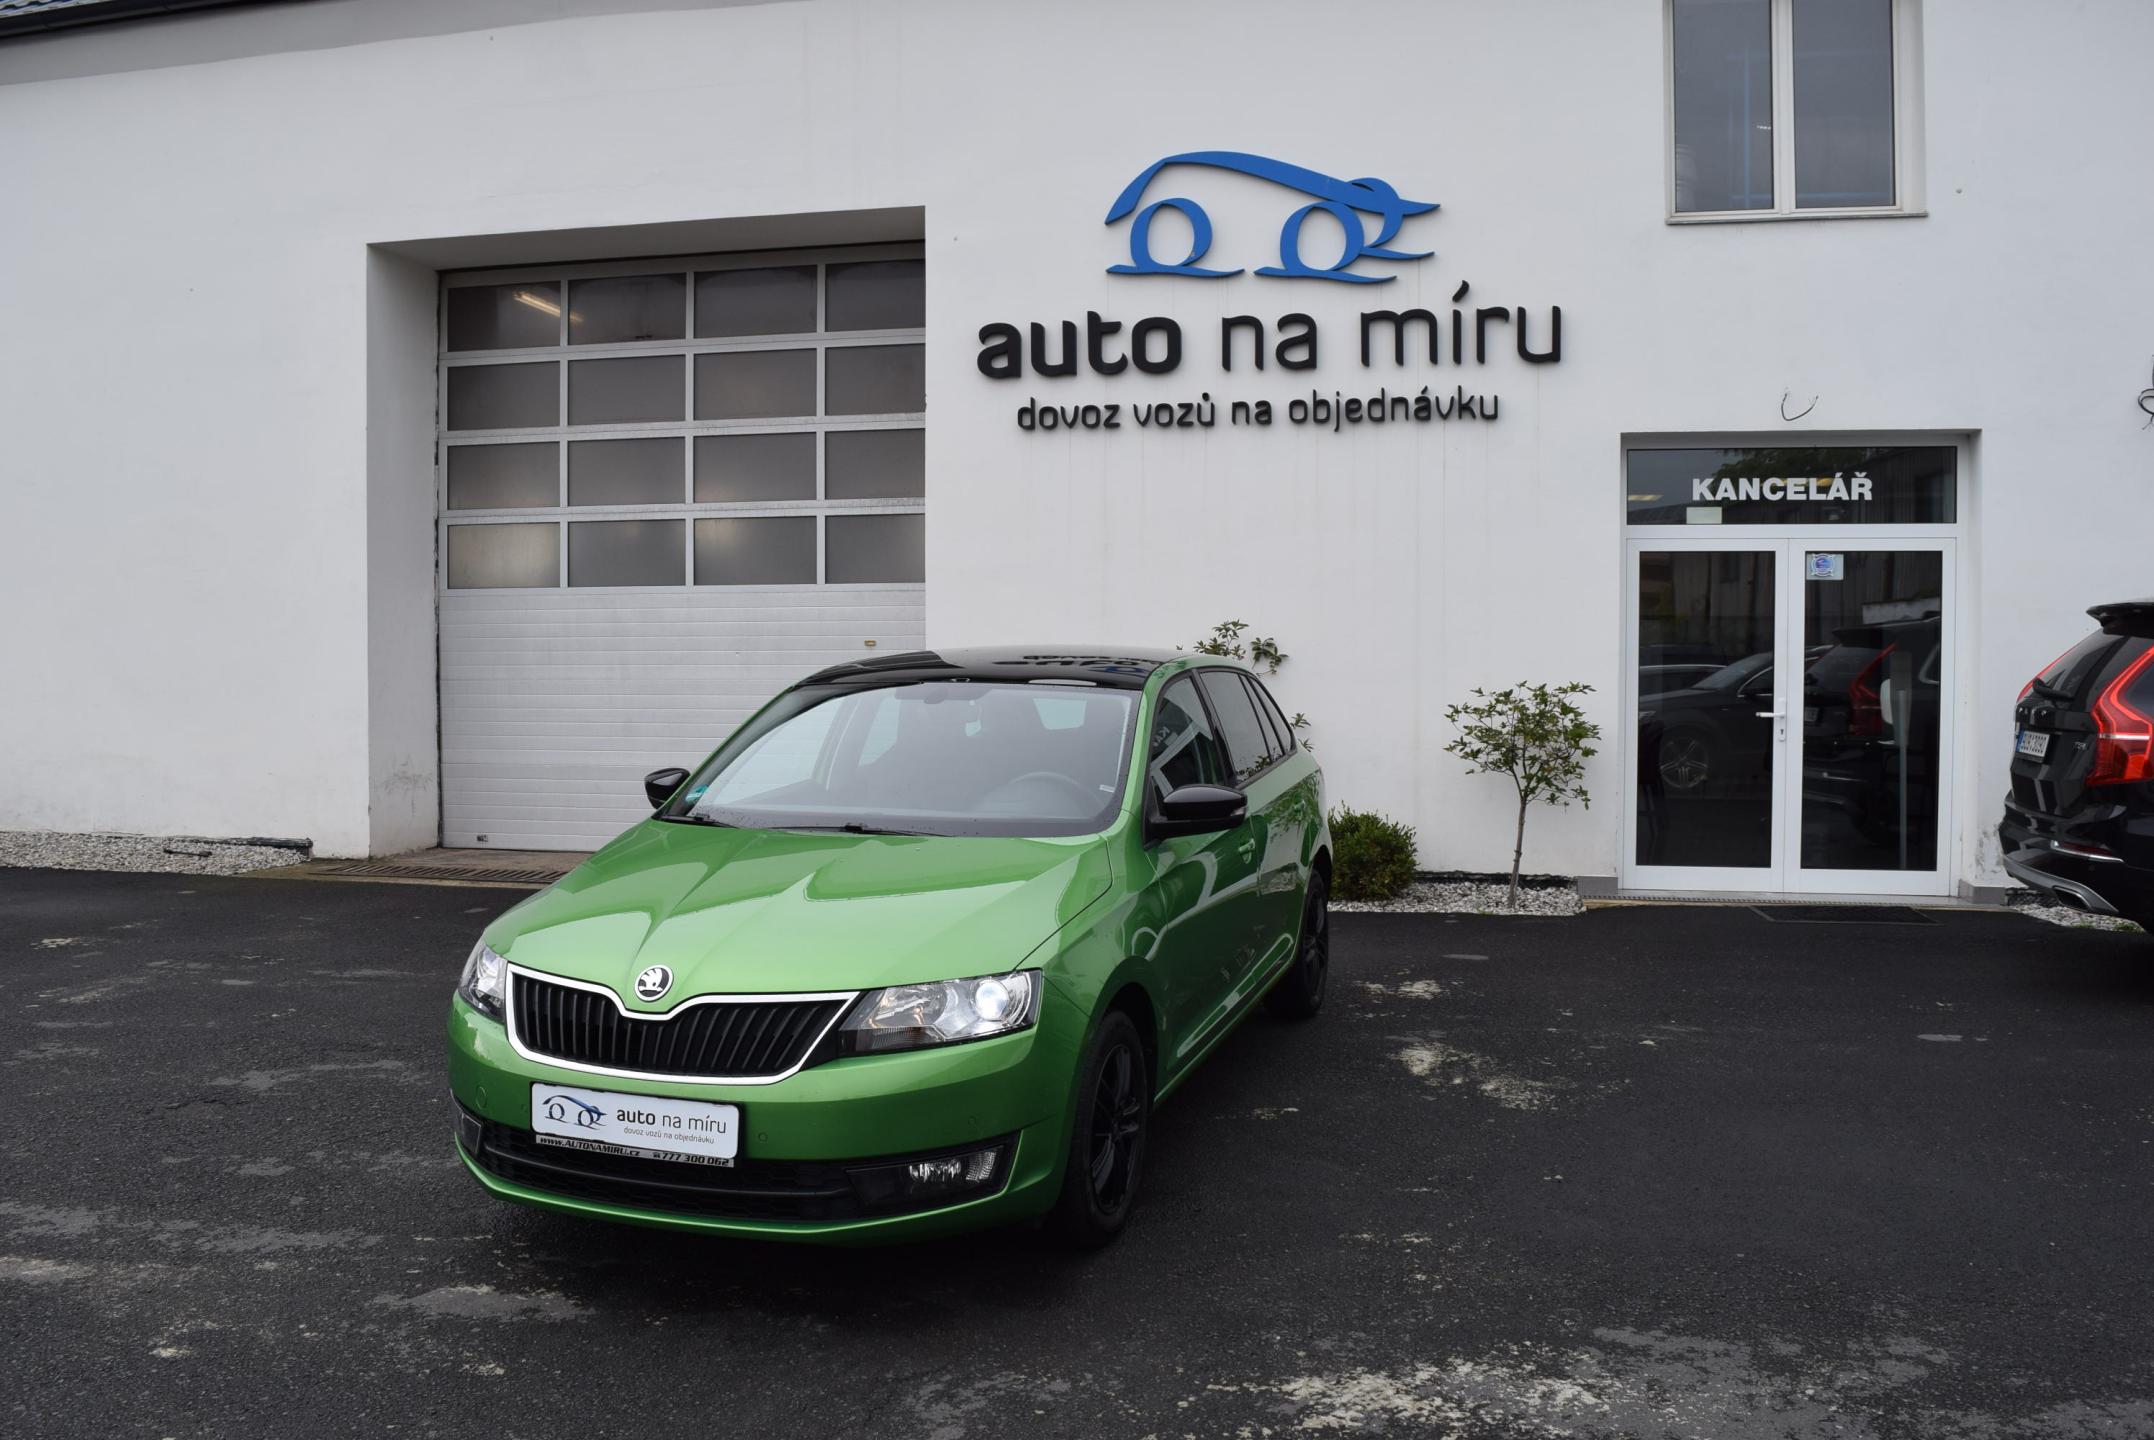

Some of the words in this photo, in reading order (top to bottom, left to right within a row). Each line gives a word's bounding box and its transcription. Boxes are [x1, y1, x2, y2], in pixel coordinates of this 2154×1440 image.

[976, 310, 1182, 380] auto
[1221, 312, 1318, 372] na
[1360, 280, 1562, 368] míru
[1017, 397, 1120, 431] dovoz
[1133, 392, 1216, 429] vozů
[1231, 398, 1273, 426] na
[1288, 385, 1499, 433] objednávku
[1692, 472, 1873, 501] KANCELÁŘ
[616, 1109, 656, 1125] auto
[662, 1115, 681, 1129] na
[688, 1114, 727, 1134] míru
[623, 1126, 644, 1136] dovoz
[645, 1129, 662, 1138] vozů
[674, 1133, 715, 1144] objednávku
[685, 1154, 705, 1164] 300
[706, 1156, 730, 1167] 062
